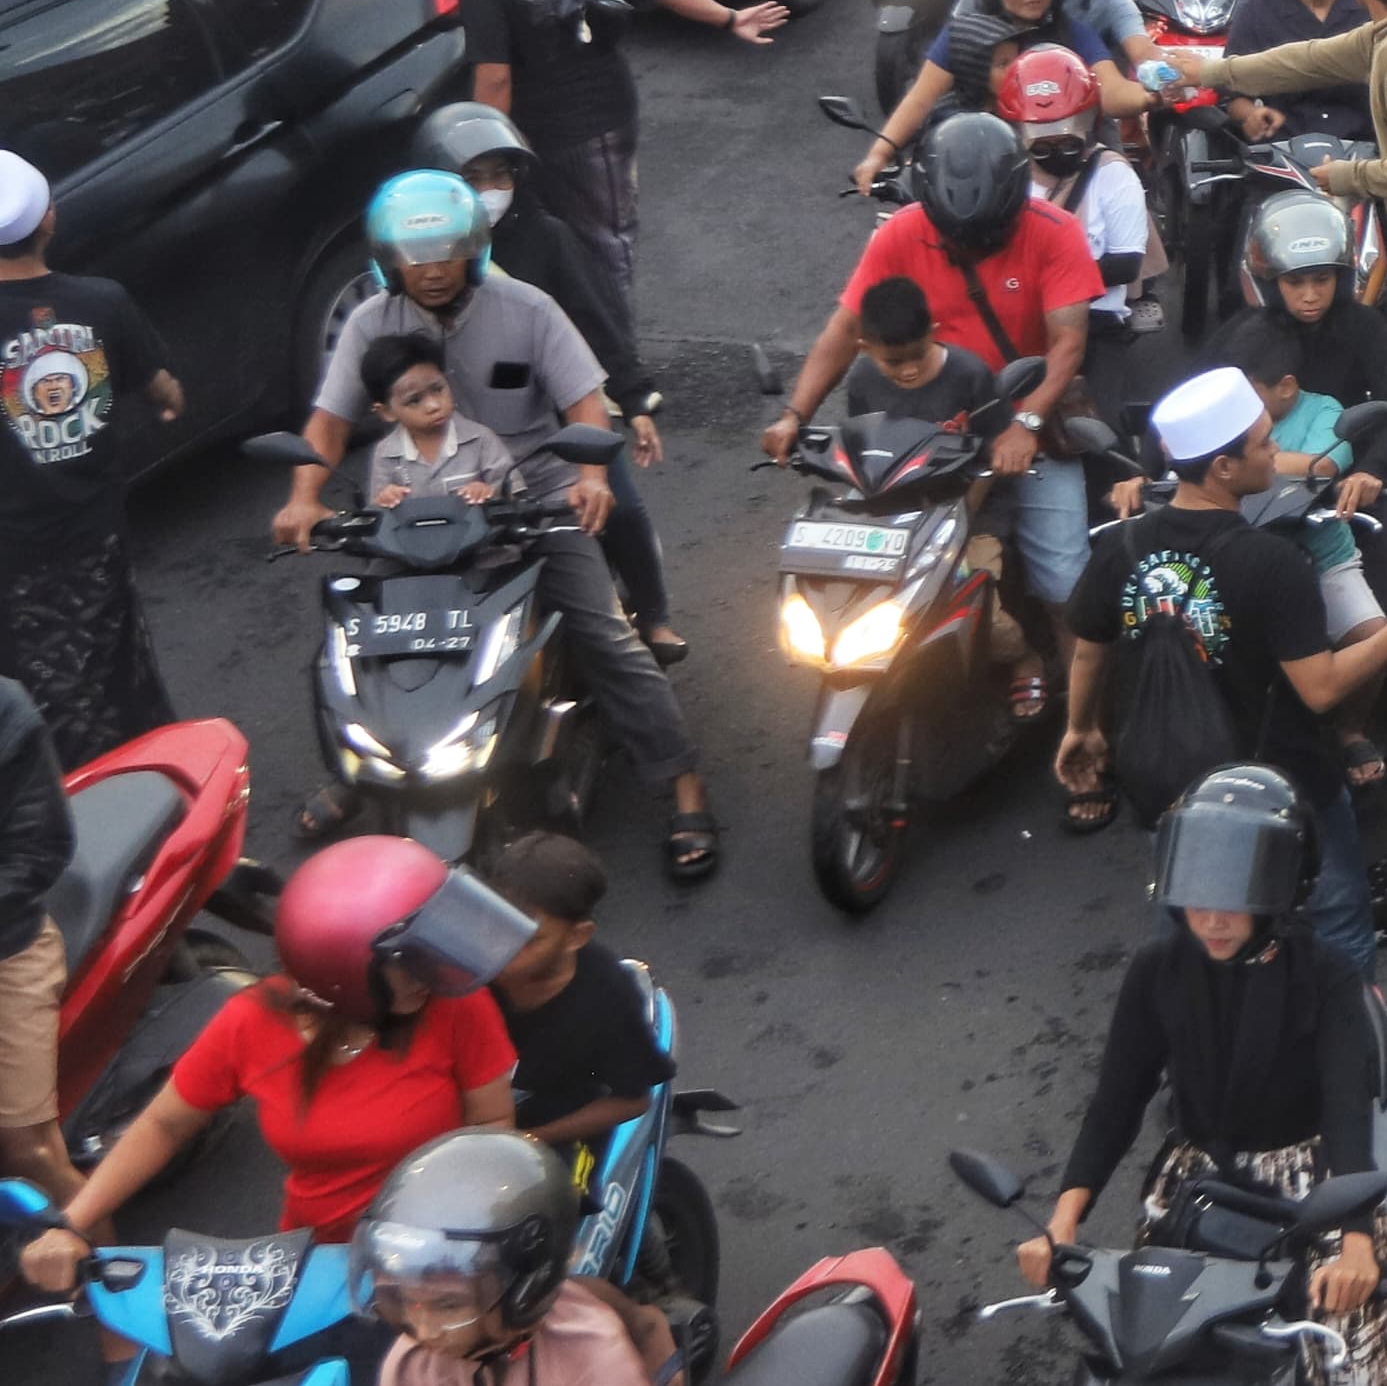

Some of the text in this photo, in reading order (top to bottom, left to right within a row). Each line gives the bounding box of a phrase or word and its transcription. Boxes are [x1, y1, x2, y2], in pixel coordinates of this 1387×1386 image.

[5, 323, 98, 370] SANTRI
[19, 396, 106, 450] ROCK
[348, 608, 474, 636] S 5948 TL
[414, 637, 471, 650] 04-27
